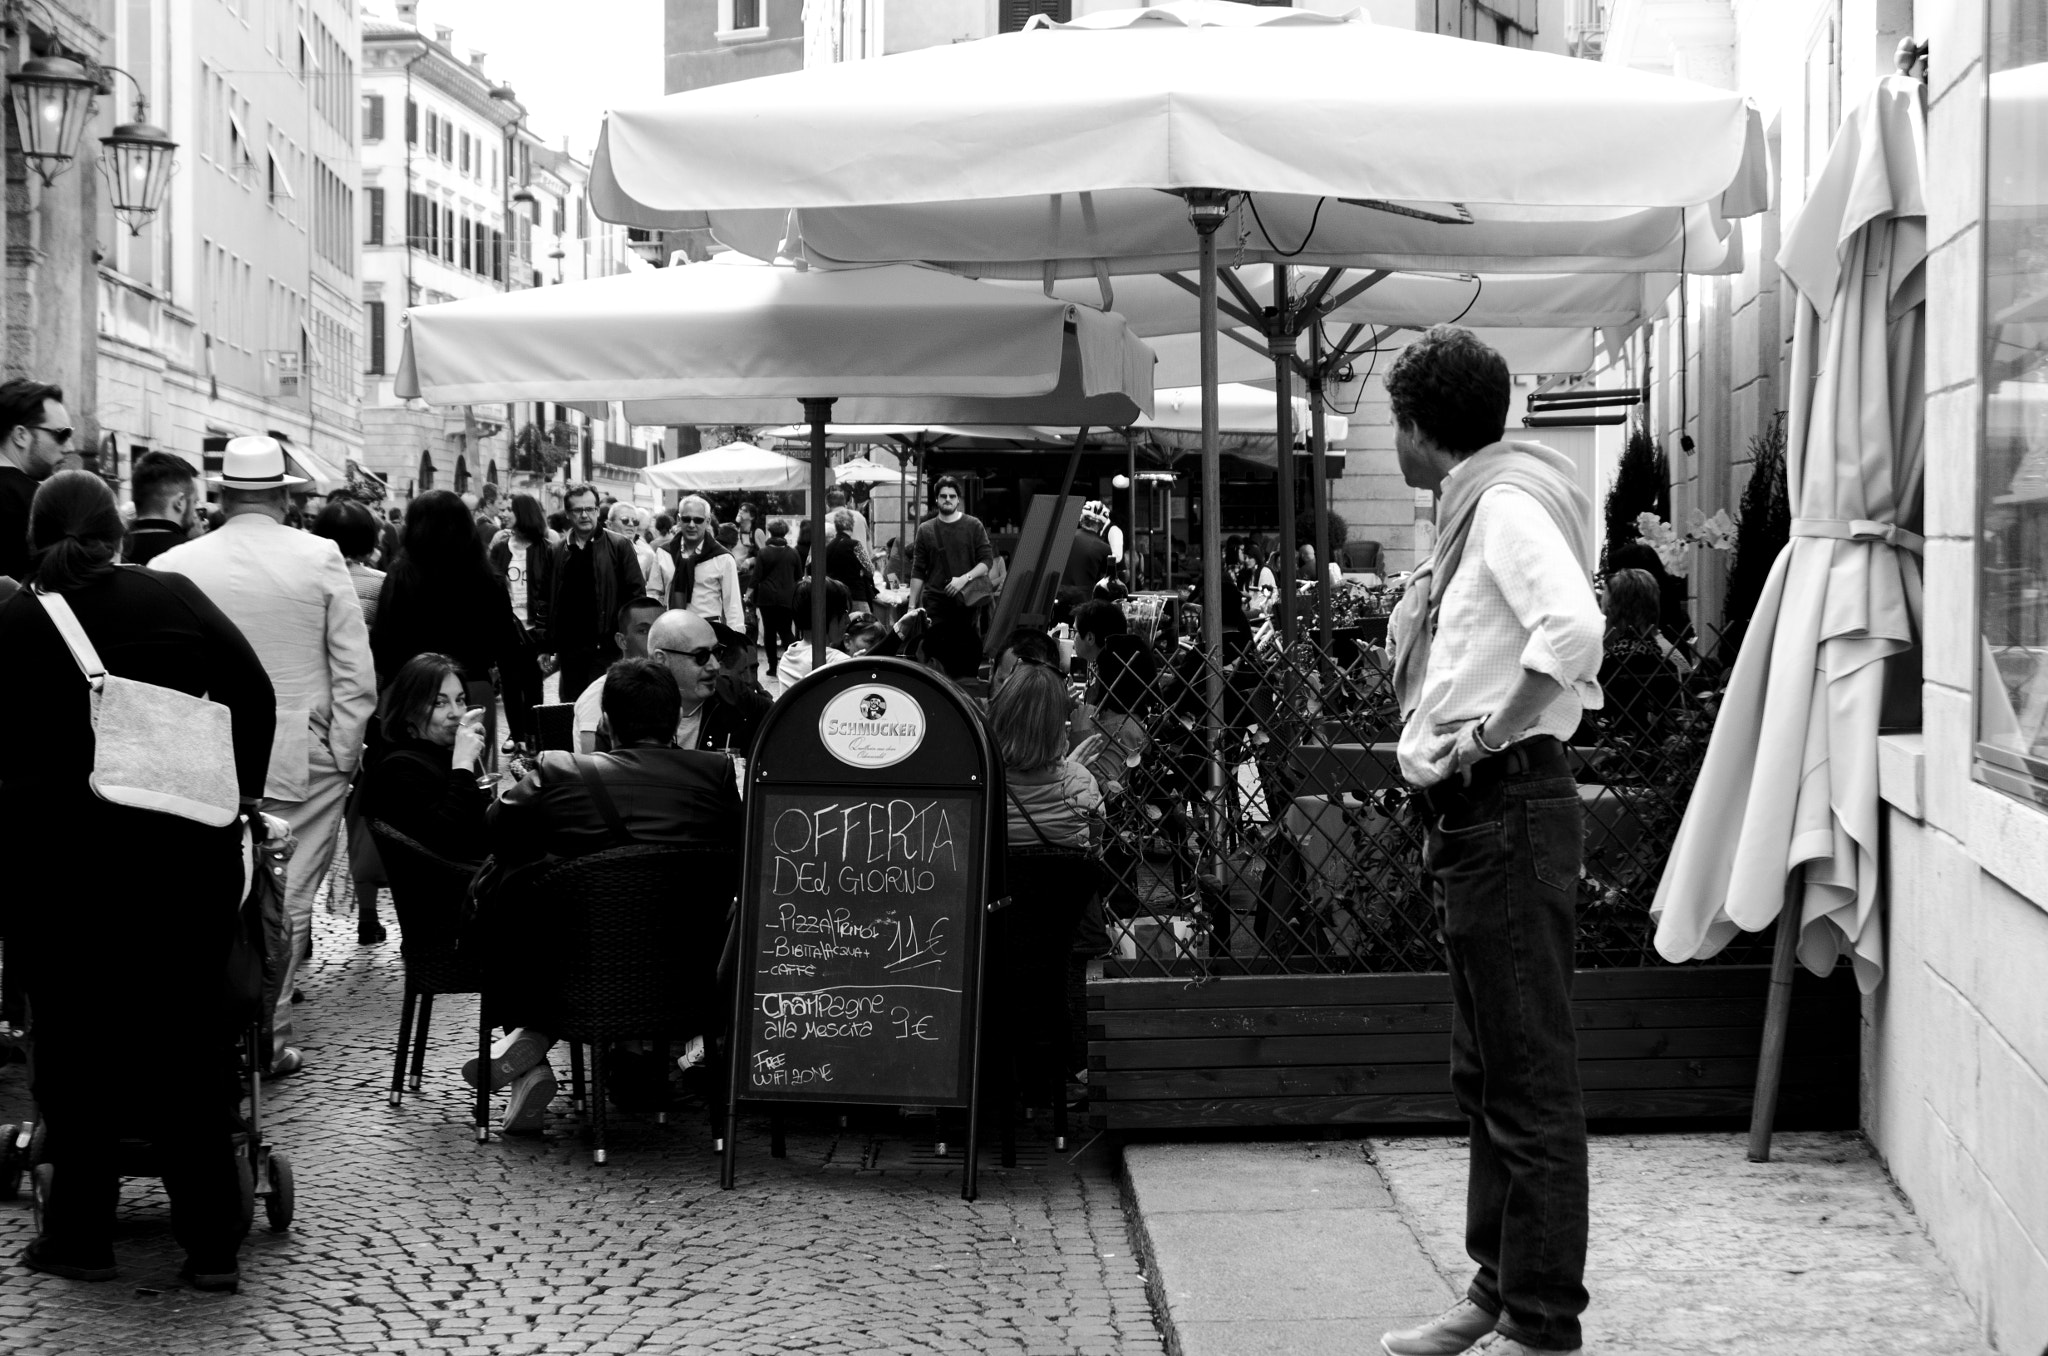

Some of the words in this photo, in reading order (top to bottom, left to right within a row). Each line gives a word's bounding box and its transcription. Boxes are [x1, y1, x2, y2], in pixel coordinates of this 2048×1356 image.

[828, 719, 917, 737] SCHMUCKER
[773, 799, 957, 872] OFFERTA
[838, 866, 936, 895] GIORNO
[764, 1015, 798, 1040] alla
